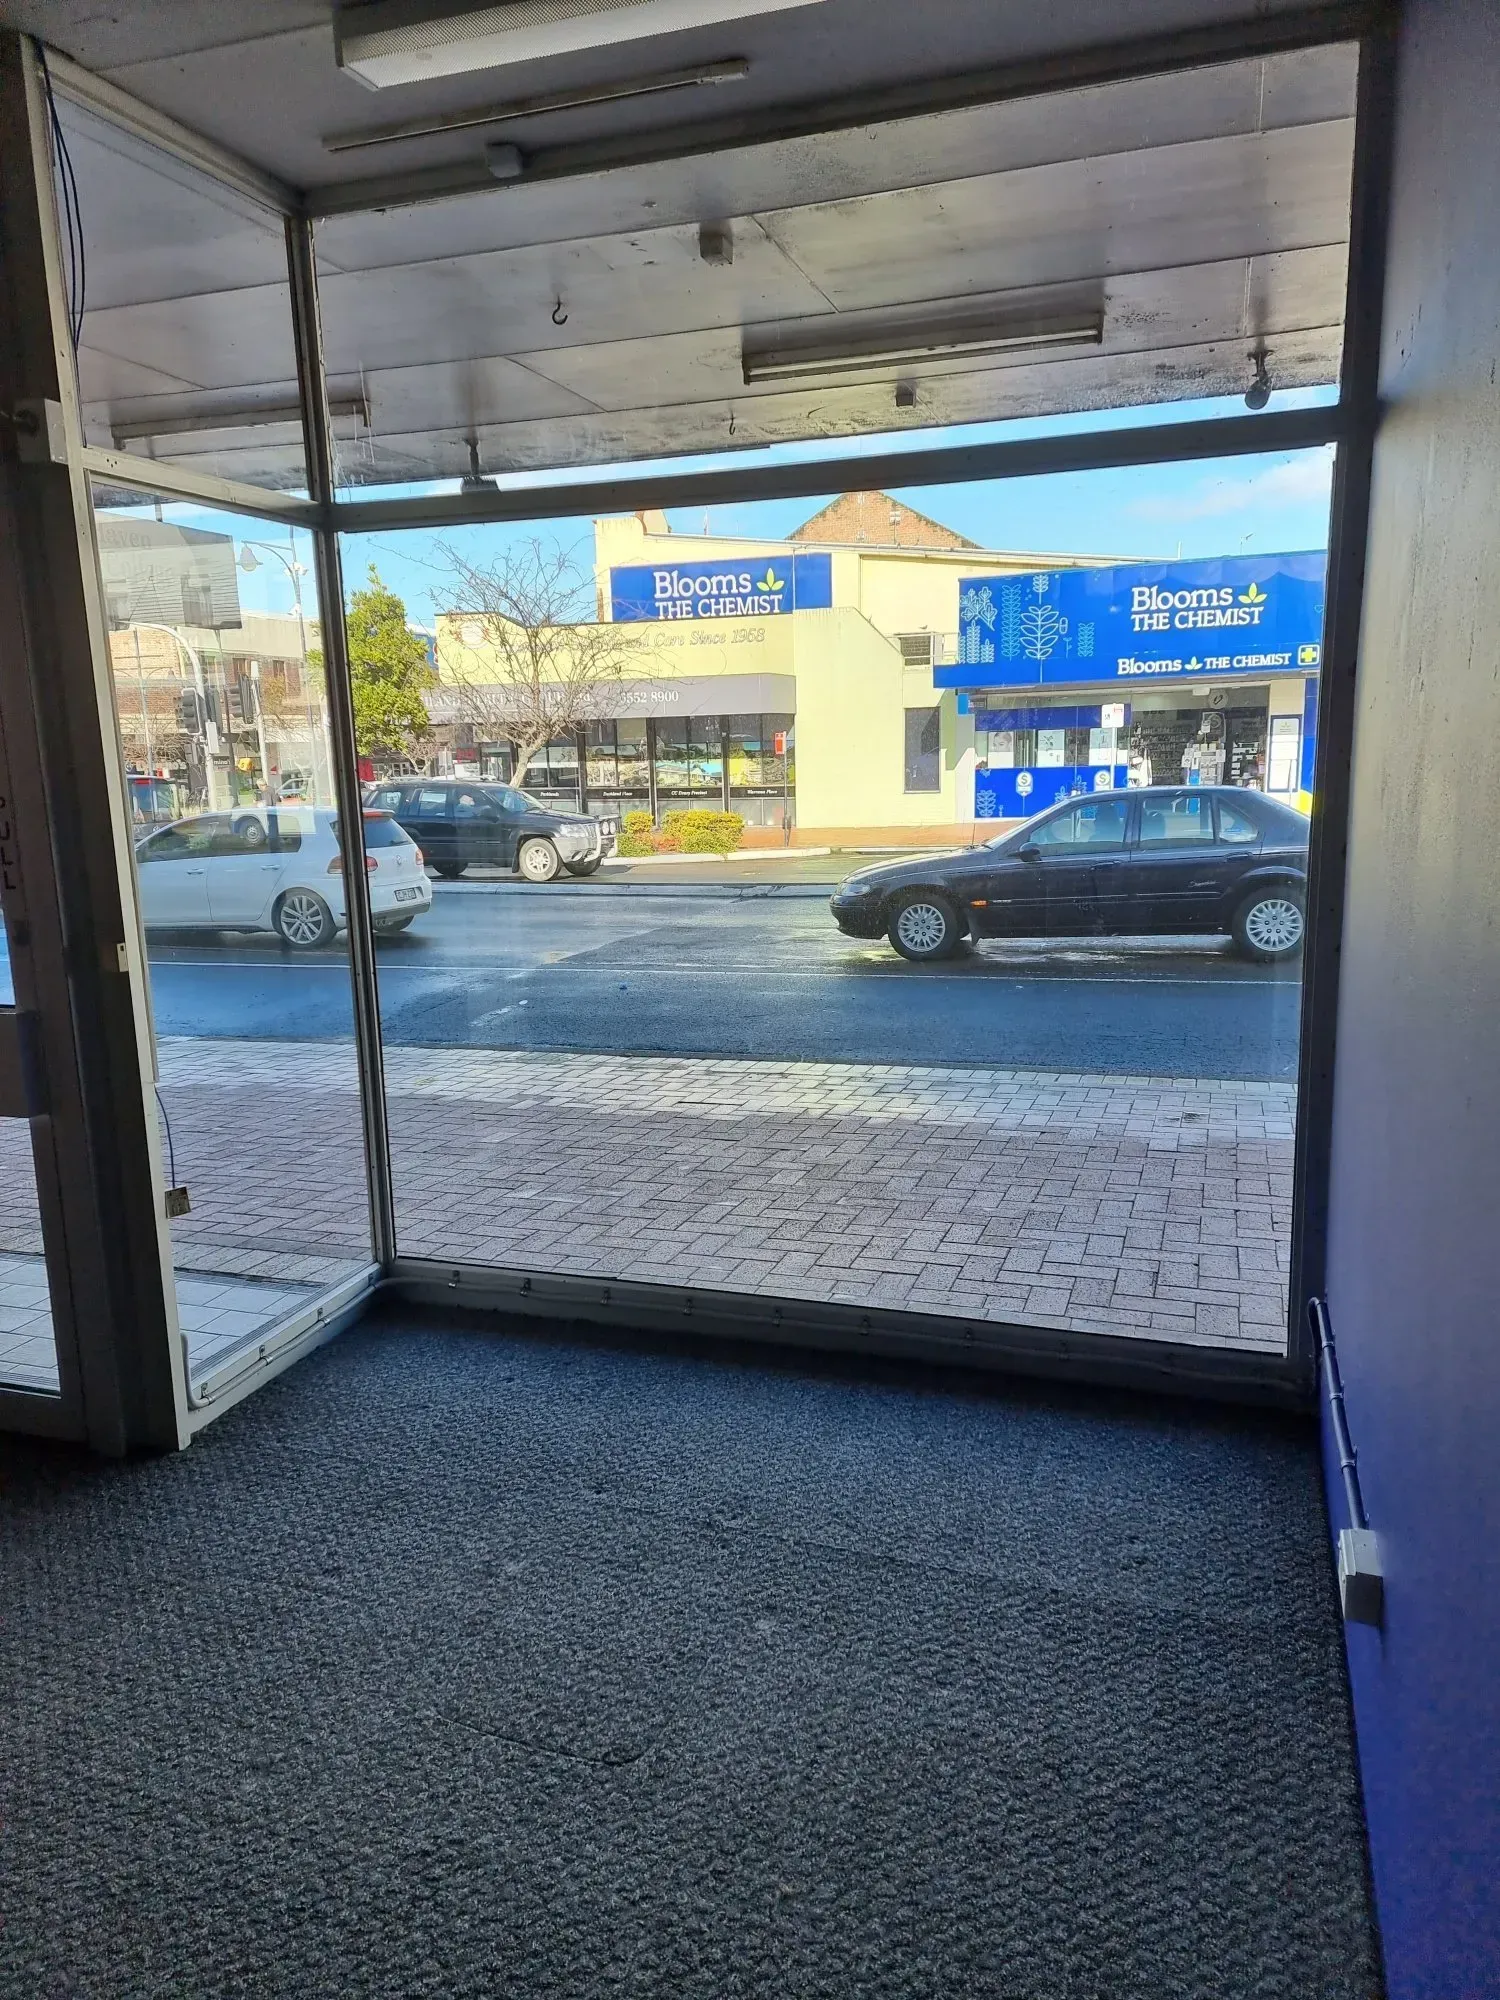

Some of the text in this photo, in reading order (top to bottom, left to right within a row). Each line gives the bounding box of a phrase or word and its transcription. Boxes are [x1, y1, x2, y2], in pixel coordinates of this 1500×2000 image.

[653, 570, 752, 598] Blooms
[655, 594, 783, 620] THE CHEMIST
[1131, 585, 1233, 612] Blooms
[1131, 607, 1264, 632] THE CHEMIST
[689, 630, 726, 646] Since
[1117, 653, 1292, 675] Blooms THE CHEMIST
[650, 690, 679, 702] 8900
